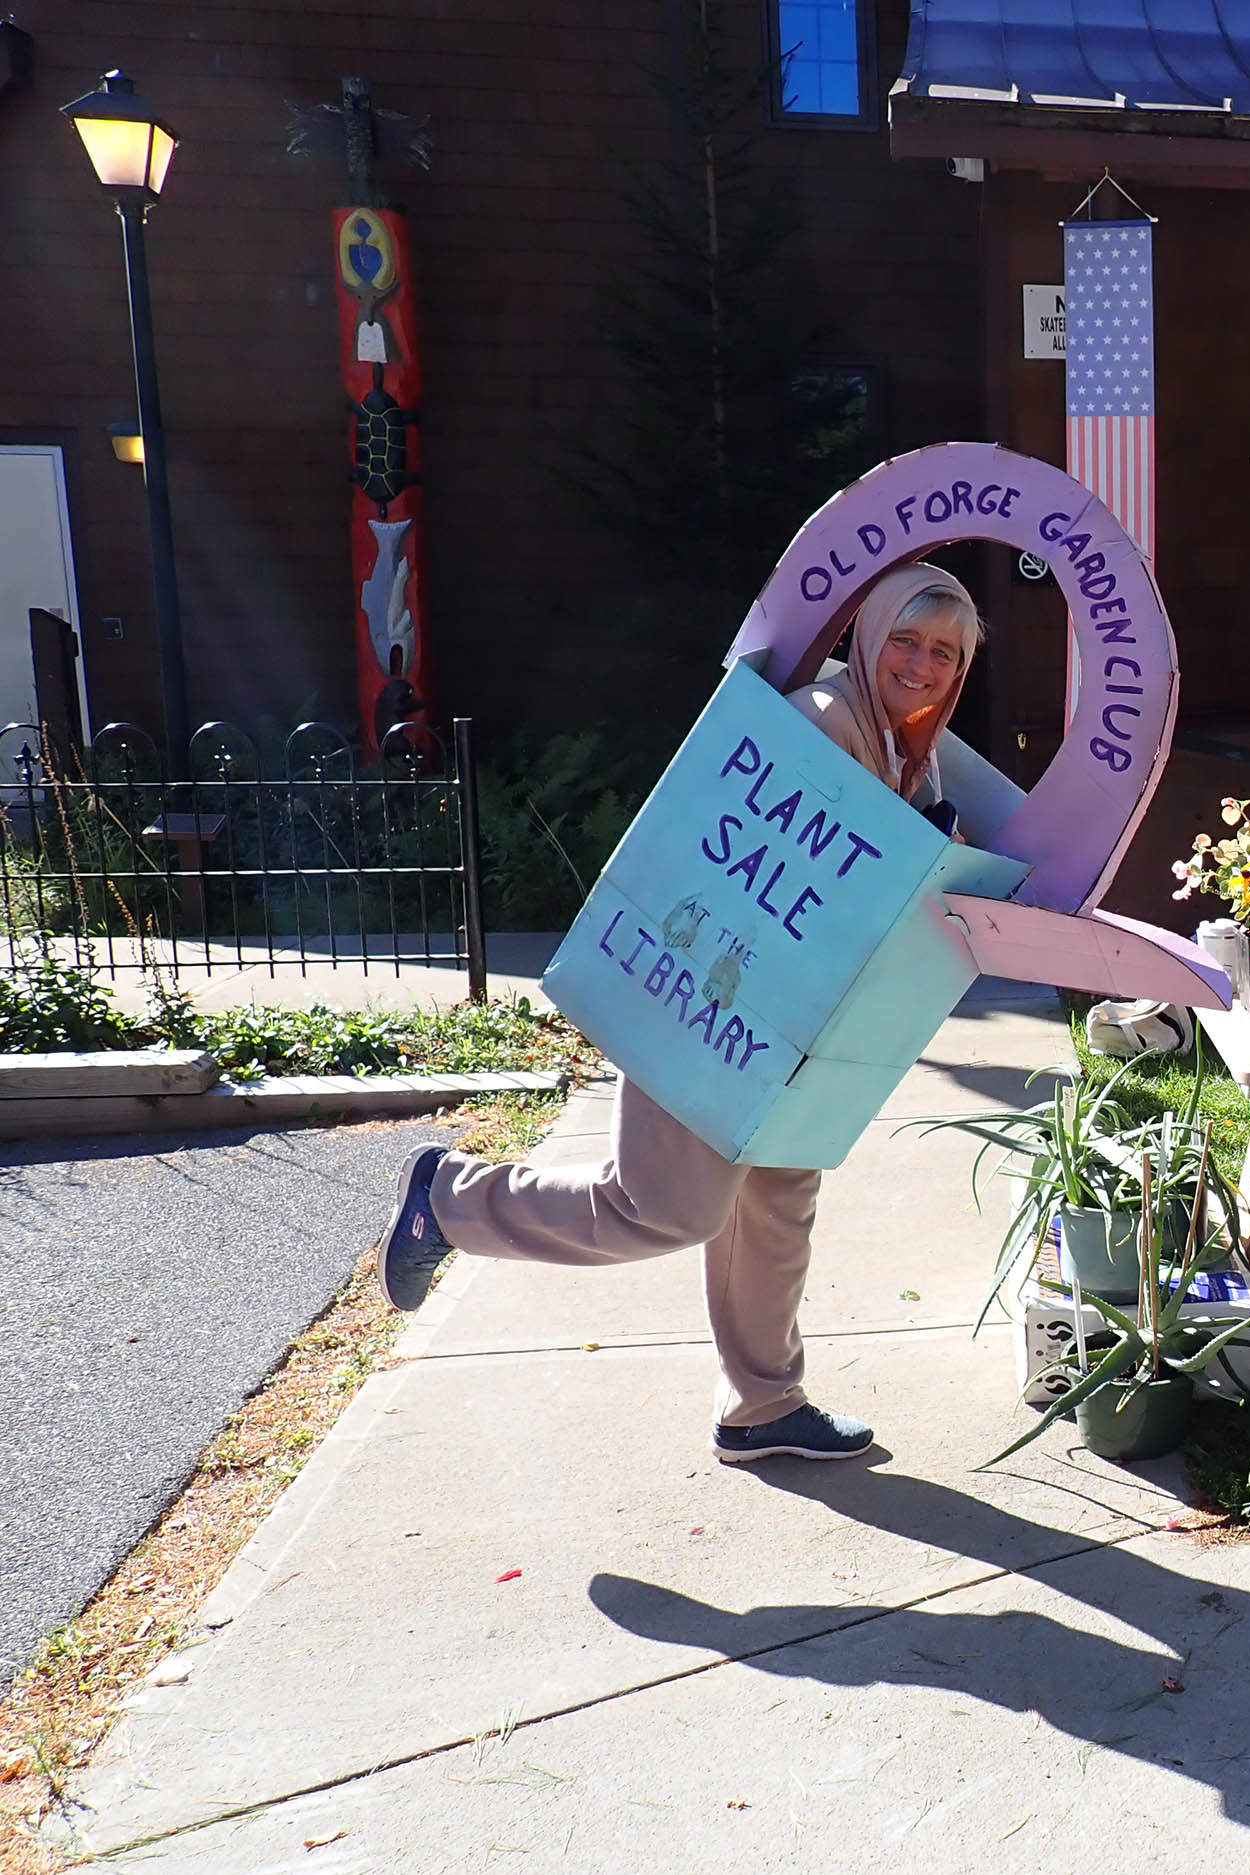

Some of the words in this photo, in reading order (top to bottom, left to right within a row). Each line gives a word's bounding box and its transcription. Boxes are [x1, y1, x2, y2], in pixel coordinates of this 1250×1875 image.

[801, 523, 886, 602] OLD
[896, 481, 1021, 534] FORGE
[1039, 512, 1137, 644] GARDEN
[702, 814, 824, 941] SALE
[720, 735, 882, 879] PLANT
[599, 909, 769, 1071] LIBRARY
[684, 901, 711, 927] AT
[717, 928, 758, 969] THE
